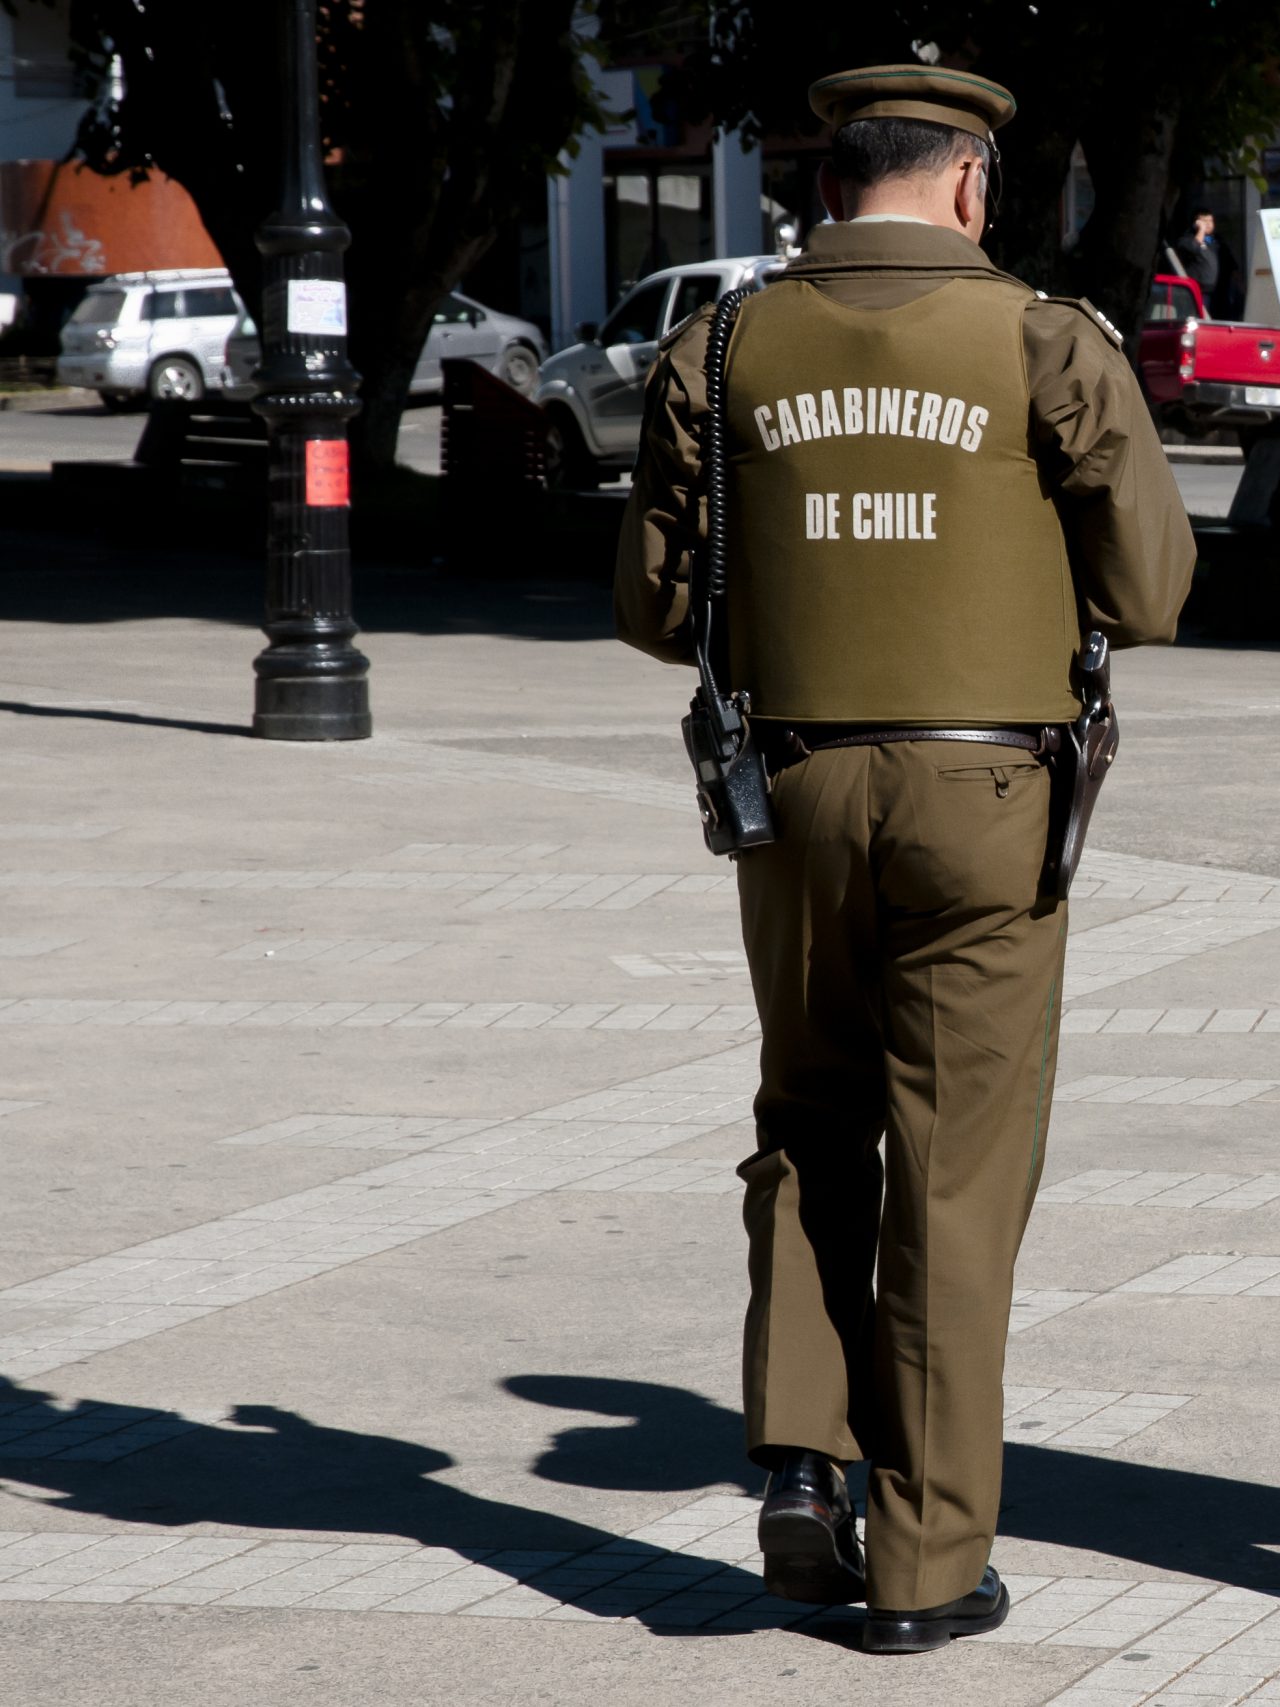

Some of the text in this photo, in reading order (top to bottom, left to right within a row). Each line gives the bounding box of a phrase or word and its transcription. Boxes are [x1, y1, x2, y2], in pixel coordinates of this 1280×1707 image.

[754, 387, 991, 453] CARABINEROS
[805, 492, 938, 541] DE CHILE
